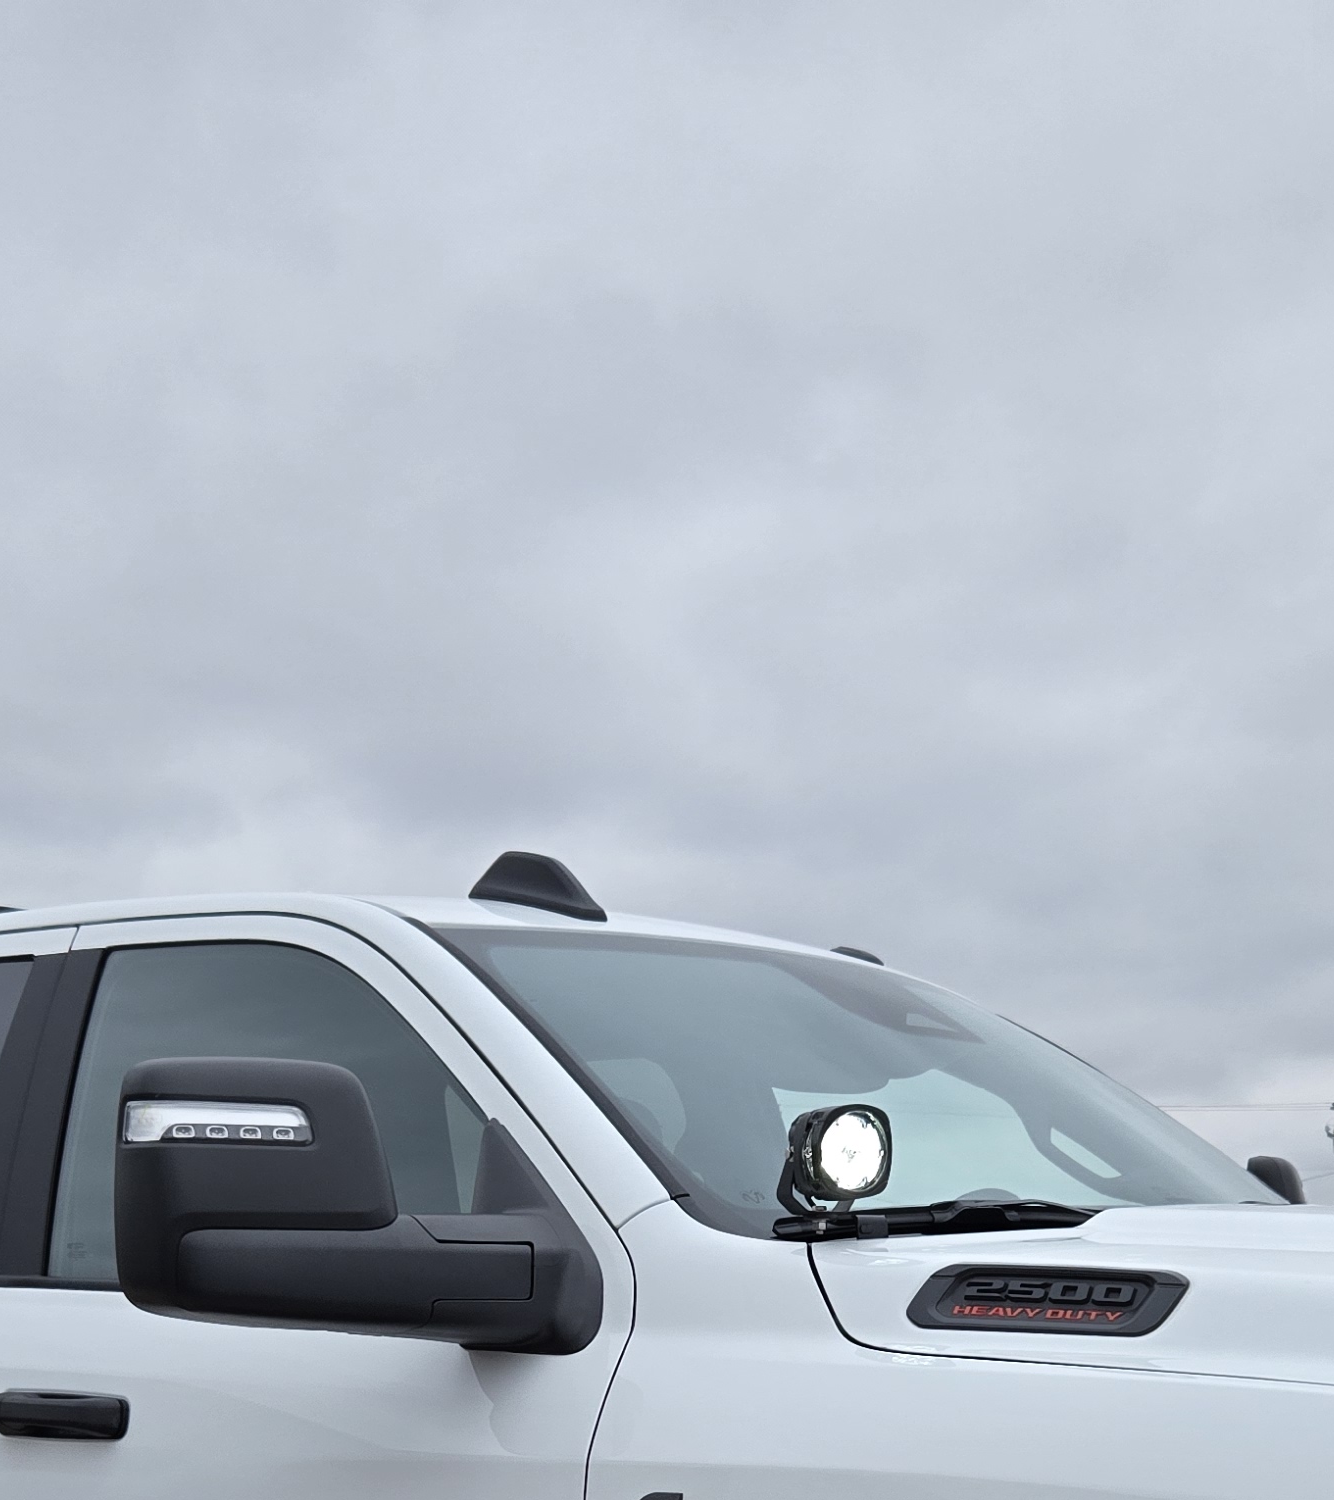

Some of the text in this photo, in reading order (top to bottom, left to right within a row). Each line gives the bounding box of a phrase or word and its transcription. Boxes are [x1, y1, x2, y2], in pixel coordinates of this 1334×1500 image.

[964, 1279, 1138, 1305] 2500
[952, 1304, 1124, 1321] HEAVY DUTY
